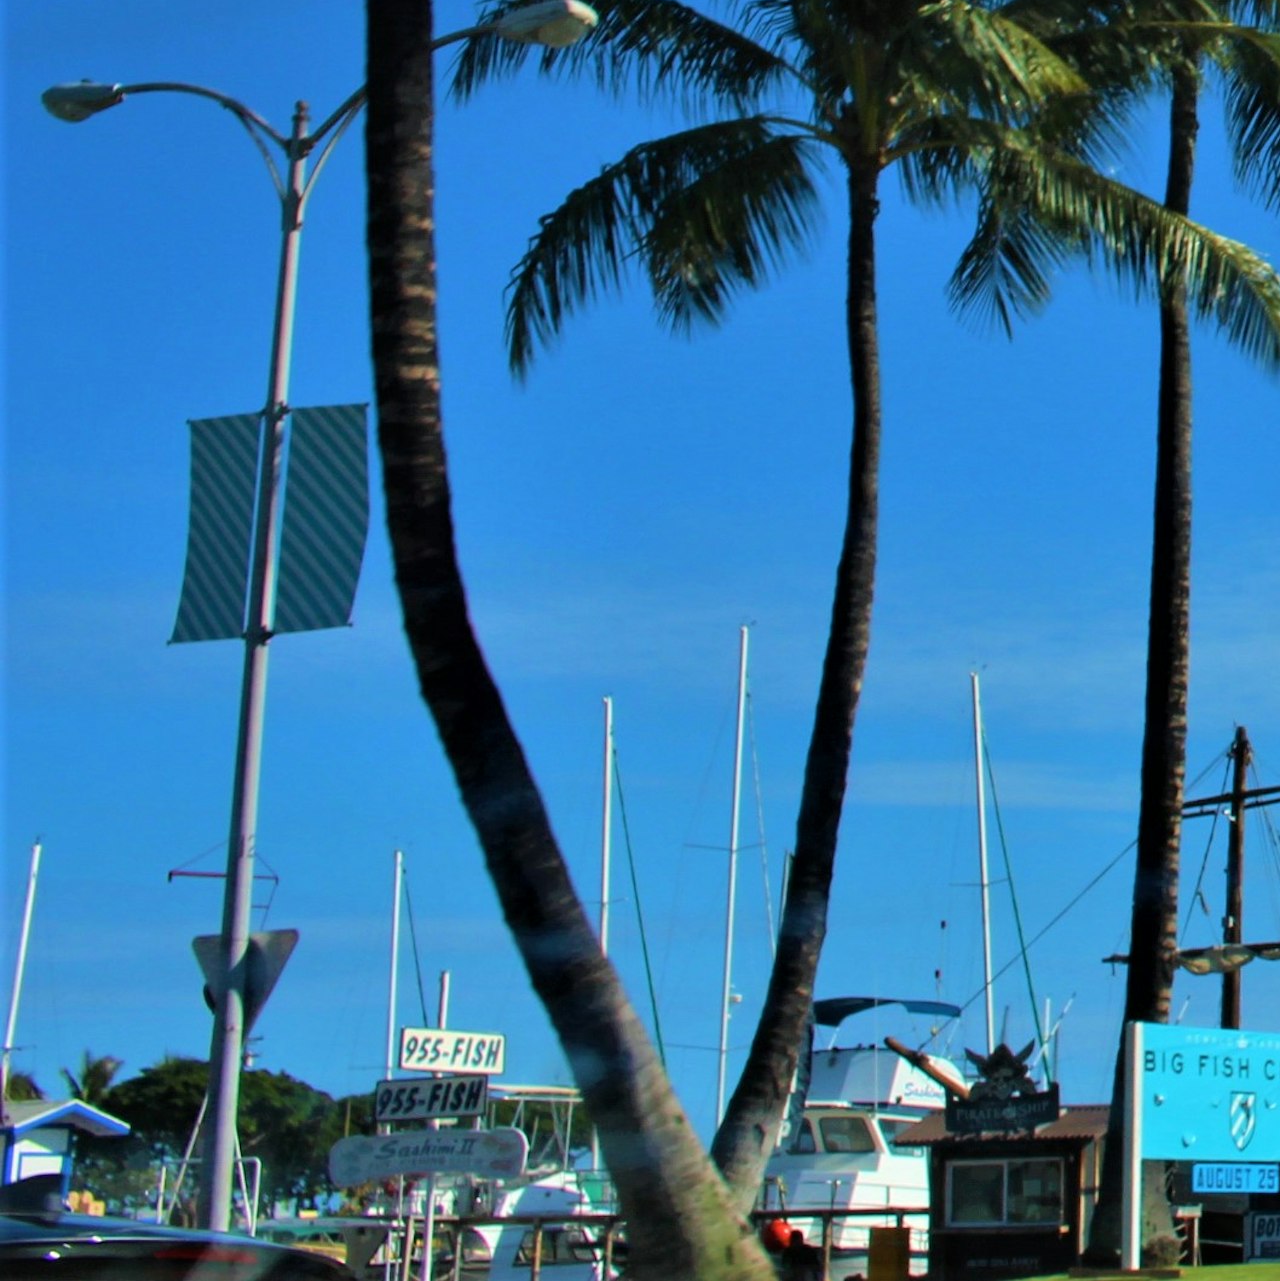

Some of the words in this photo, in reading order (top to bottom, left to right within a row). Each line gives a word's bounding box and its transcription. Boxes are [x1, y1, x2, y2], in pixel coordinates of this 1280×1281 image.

[403, 1035, 502, 1068] 955-FISH
[1144, 1050, 1184, 1074] BIG
[1199, 1055, 1250, 1079] FISH
[377, 1080, 483, 1116] 955-FISH
[373, 1136, 456, 1160] Sashimi
[1197, 1168, 1251, 1189] AUGUST
[1258, 1168, 1276, 1189] 25
